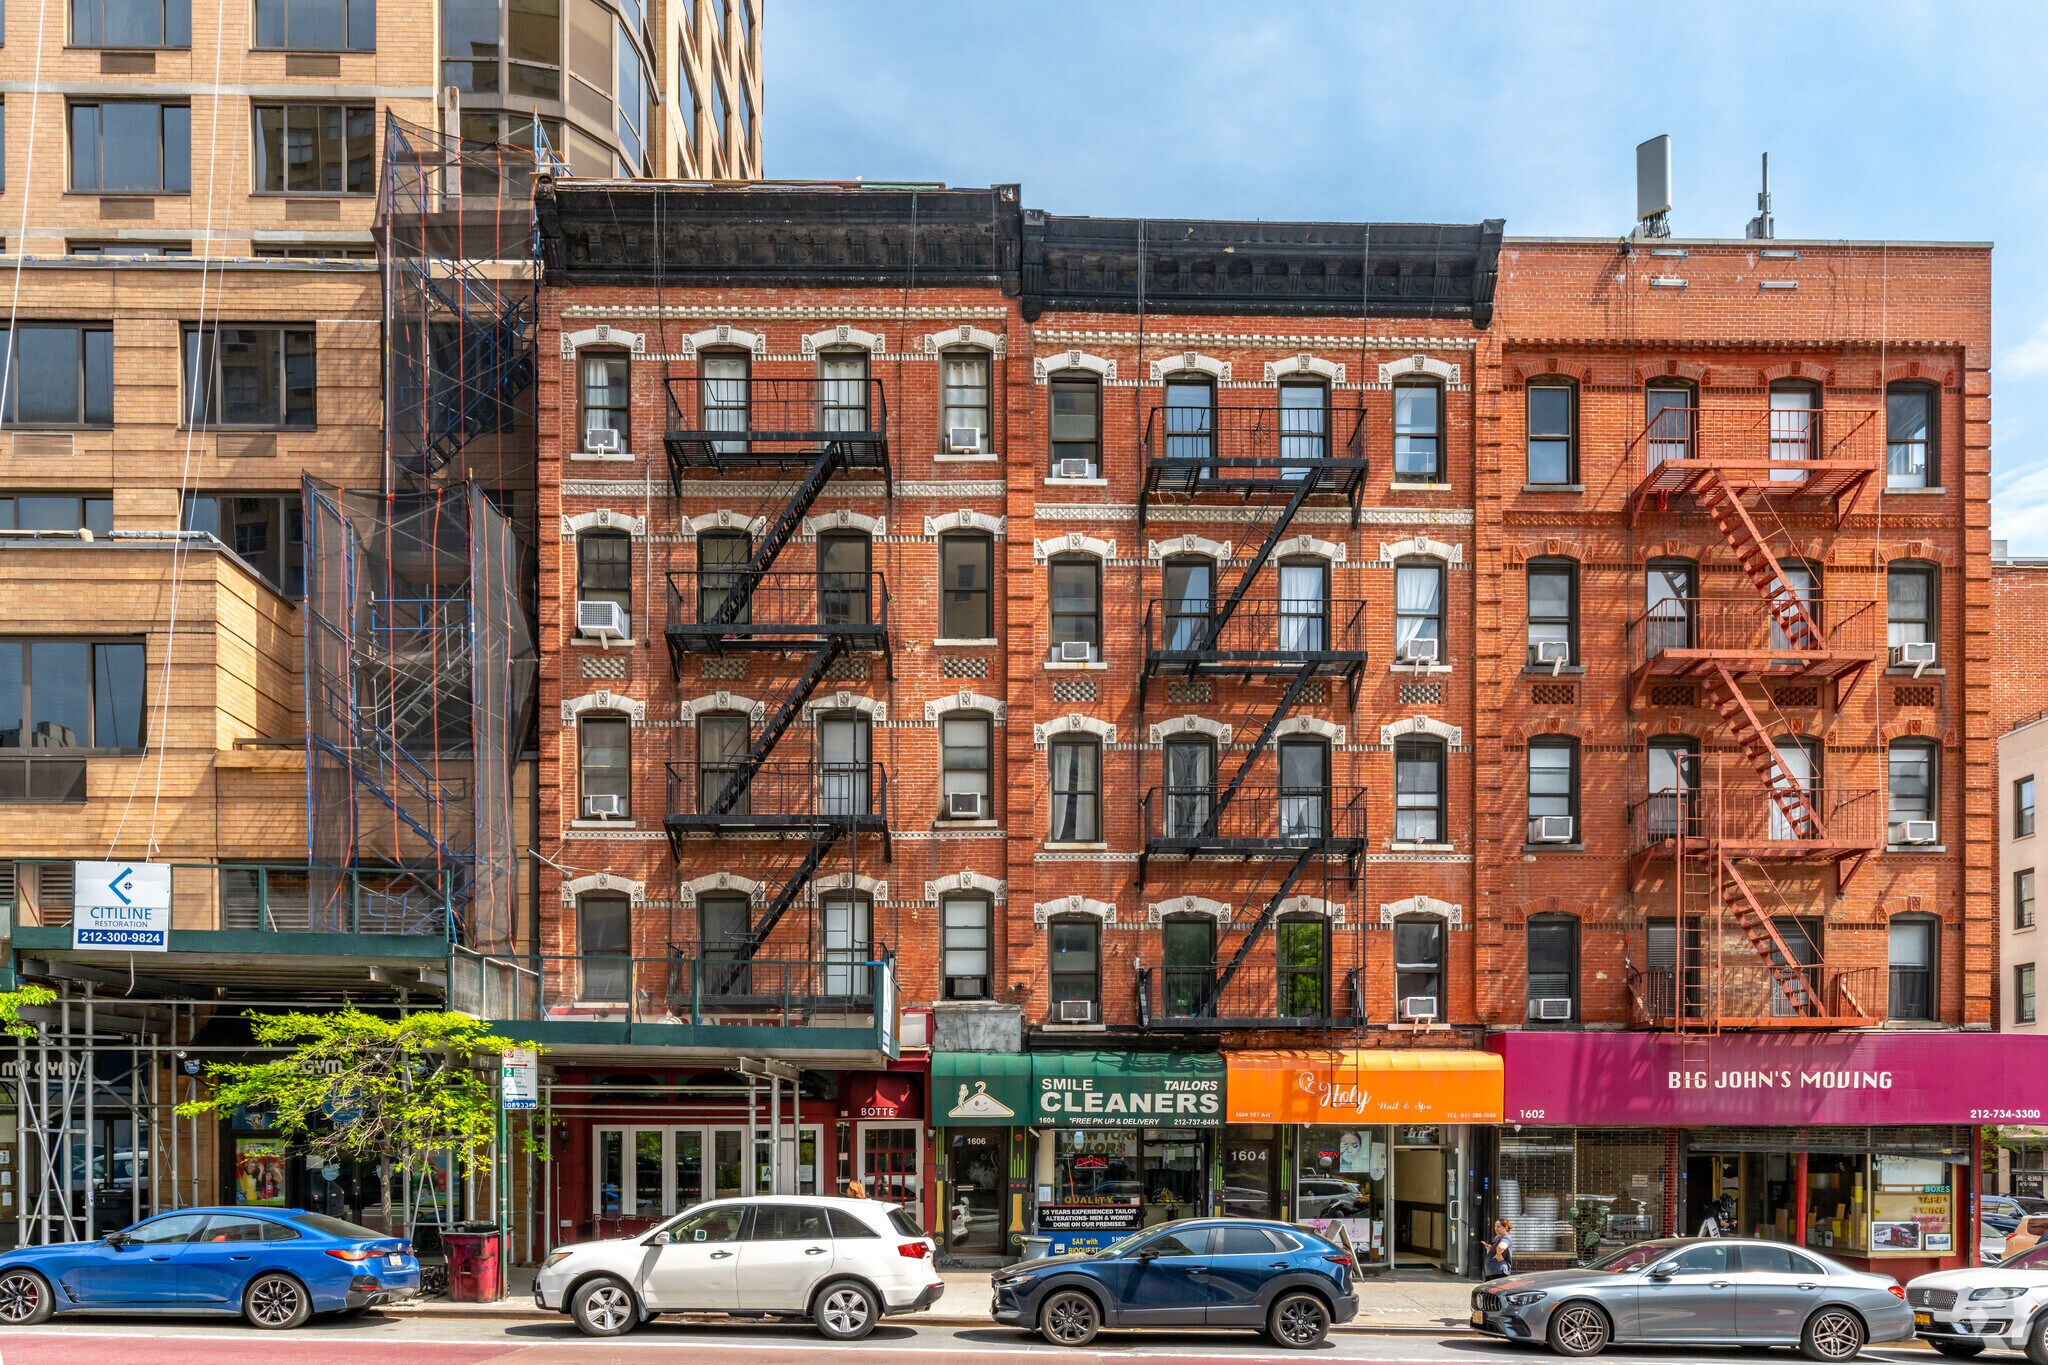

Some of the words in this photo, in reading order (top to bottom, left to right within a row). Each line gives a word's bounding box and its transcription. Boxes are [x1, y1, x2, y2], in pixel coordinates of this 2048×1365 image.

[90, 907, 152, 920] CITILINE
[81, 932, 160, 943] 212-300-9824
[1668, 1071, 1707, 1089] BIG
[1714, 1070, 1791, 1089] JOHN'S
[1800, 1071, 1892, 1089] MOVING
[1042, 1079, 1093, 1091] SMILE
[1164, 1081, 1218, 1091] TAILORS
[1040, 1092, 1219, 1114] CLEANERS
[1319, 1082, 1372, 1114] Holy
[861, 1107, 894, 1116] BOTTE
[1519, 1110, 1545, 1119] 1602
[1970, 1109, 2040, 1118] 212-734-3300
[1174, 1118, 1219, 1126] 212-737-8484
[967, 1137, 986, 1145] 1606
[1231, 1150, 1266, 1161] 1604
[1317, 1151, 1339, 1159] OPEN
[1075, 1157, 1106, 1167] OPEN
[1064, 1196, 1114, 1204] QUALITY
